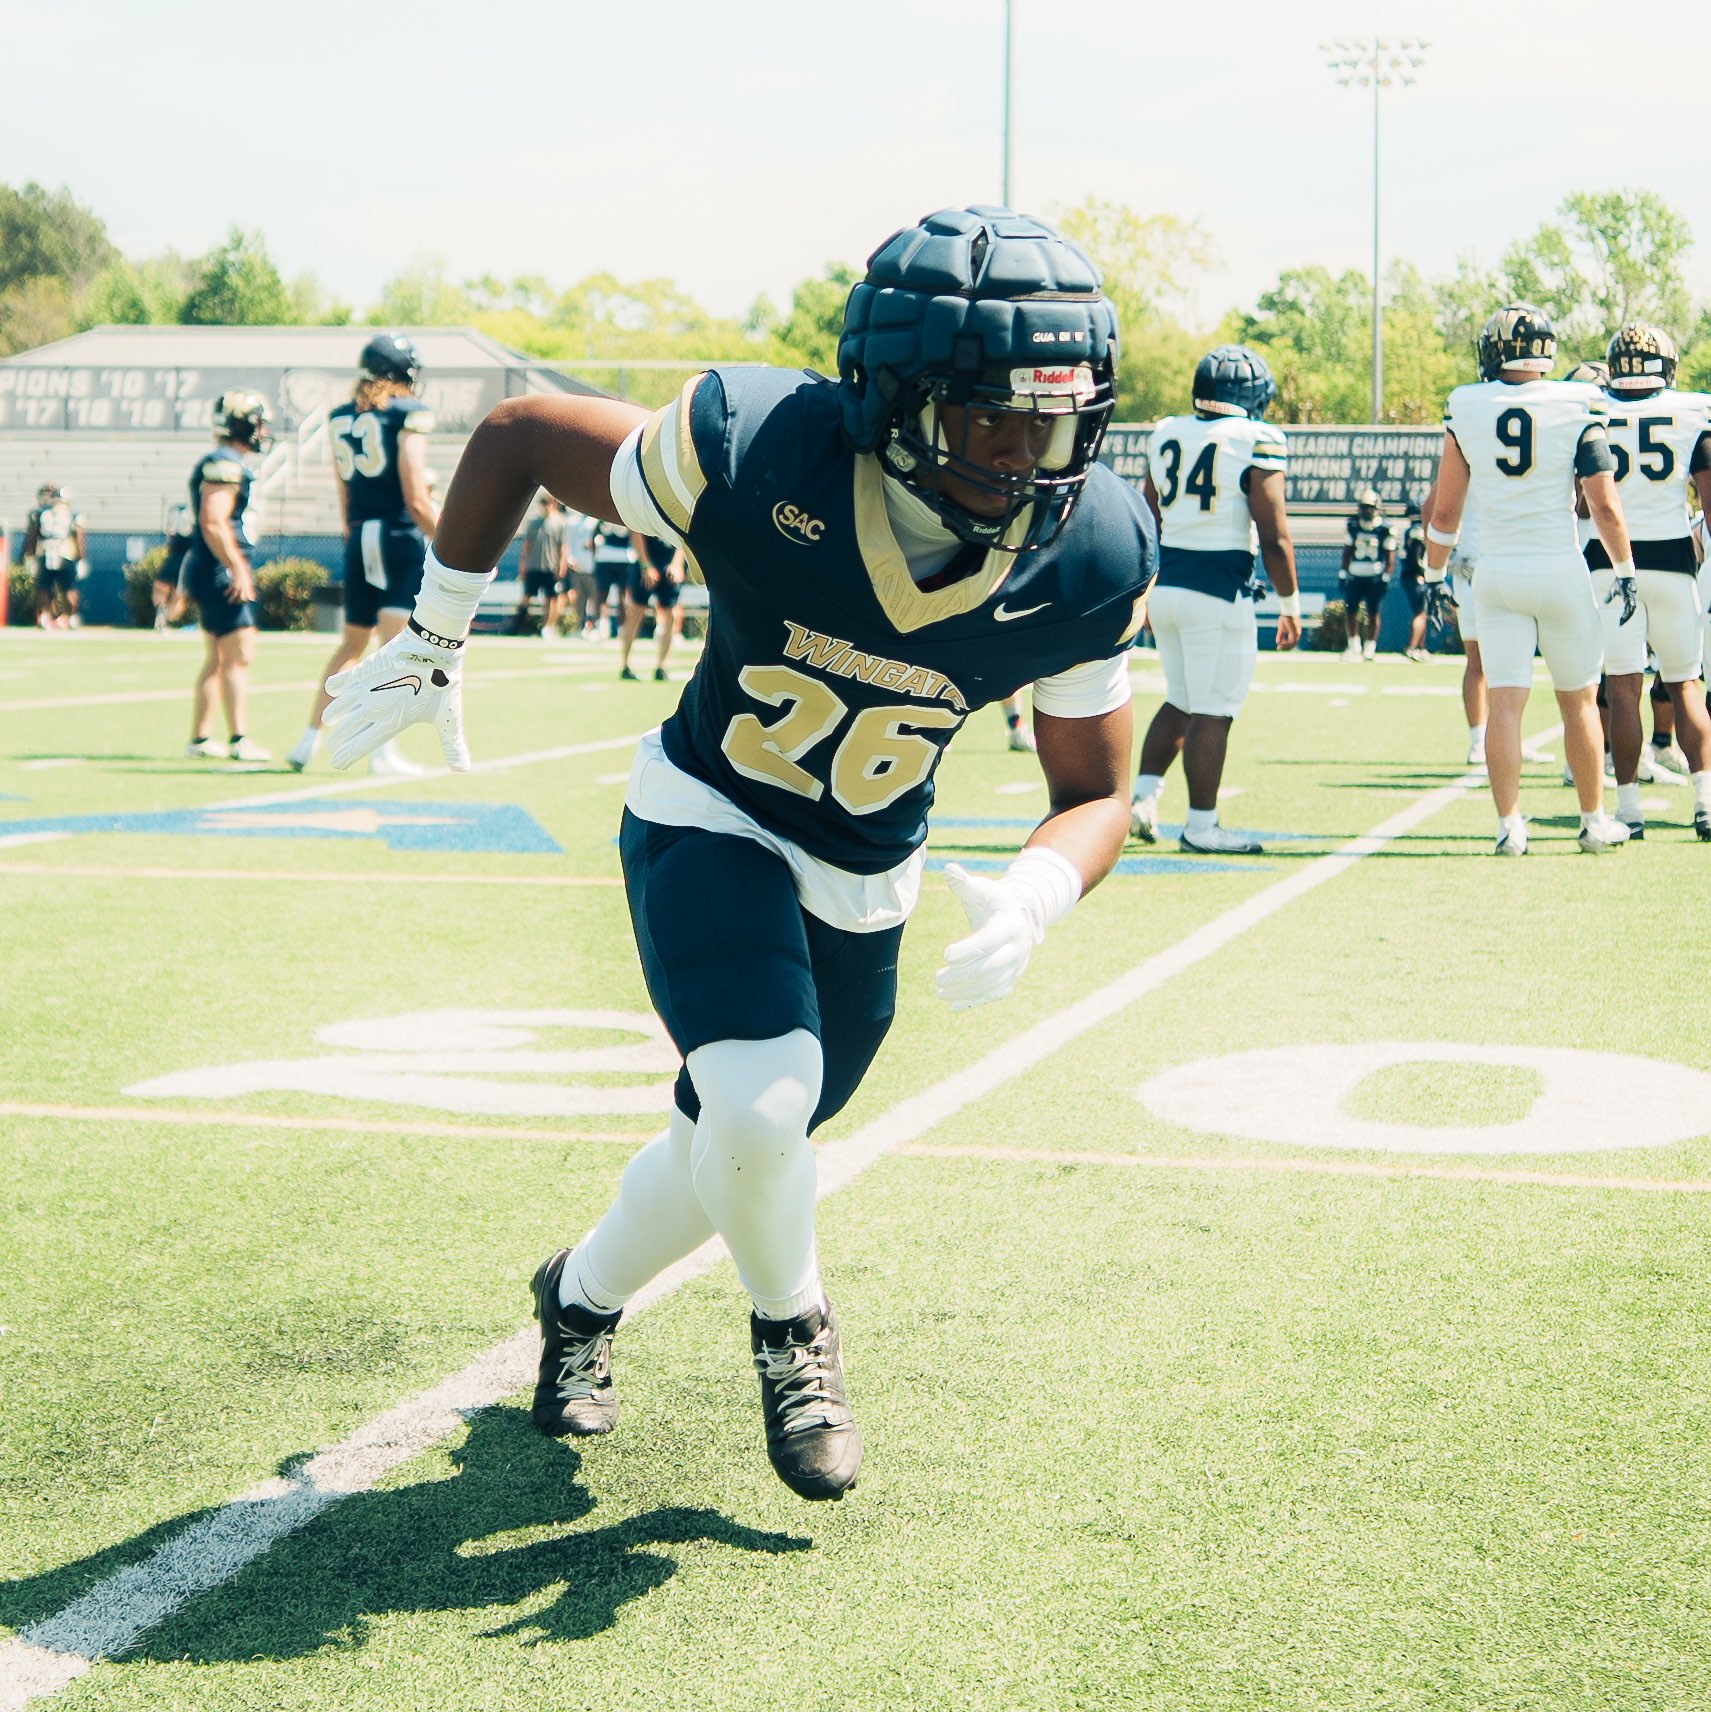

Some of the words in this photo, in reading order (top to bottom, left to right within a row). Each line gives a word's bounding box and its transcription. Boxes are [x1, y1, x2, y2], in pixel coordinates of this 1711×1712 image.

[328, 411, 387, 482] 53
[1158, 437, 1221, 515] 34
[1494, 405, 1536, 480] 9
[1606, 415, 1678, 484] 55
[778, 504, 825, 541] SAC
[720, 664, 965, 816] 26
